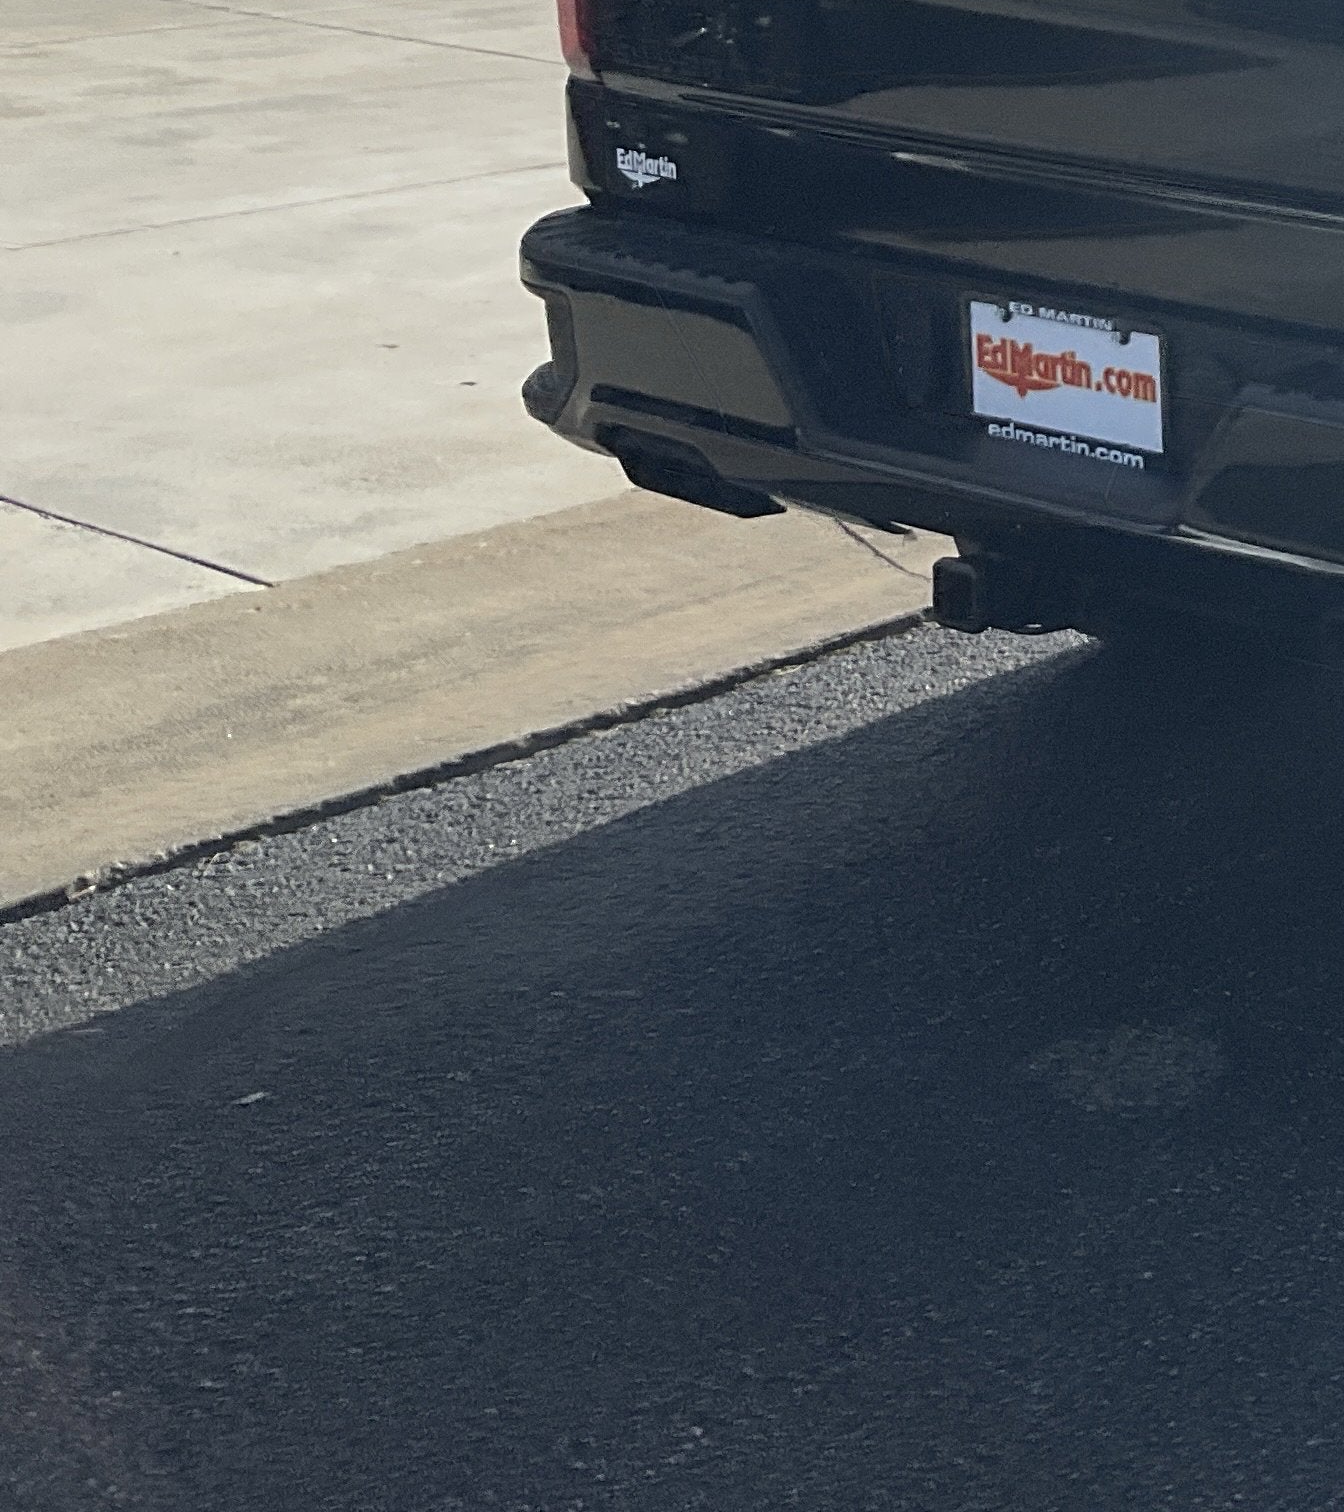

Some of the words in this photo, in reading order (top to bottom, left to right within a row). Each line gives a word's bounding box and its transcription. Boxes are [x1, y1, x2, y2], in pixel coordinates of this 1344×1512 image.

[616, 147, 677, 180] EdMartin
[1008, 301, 1033, 315] ED
[1039, 307, 1112, 331] MARTIN
[976, 332, 1157, 402] EdMartin.com
[988, 423, 1144, 470] edmartin.com
